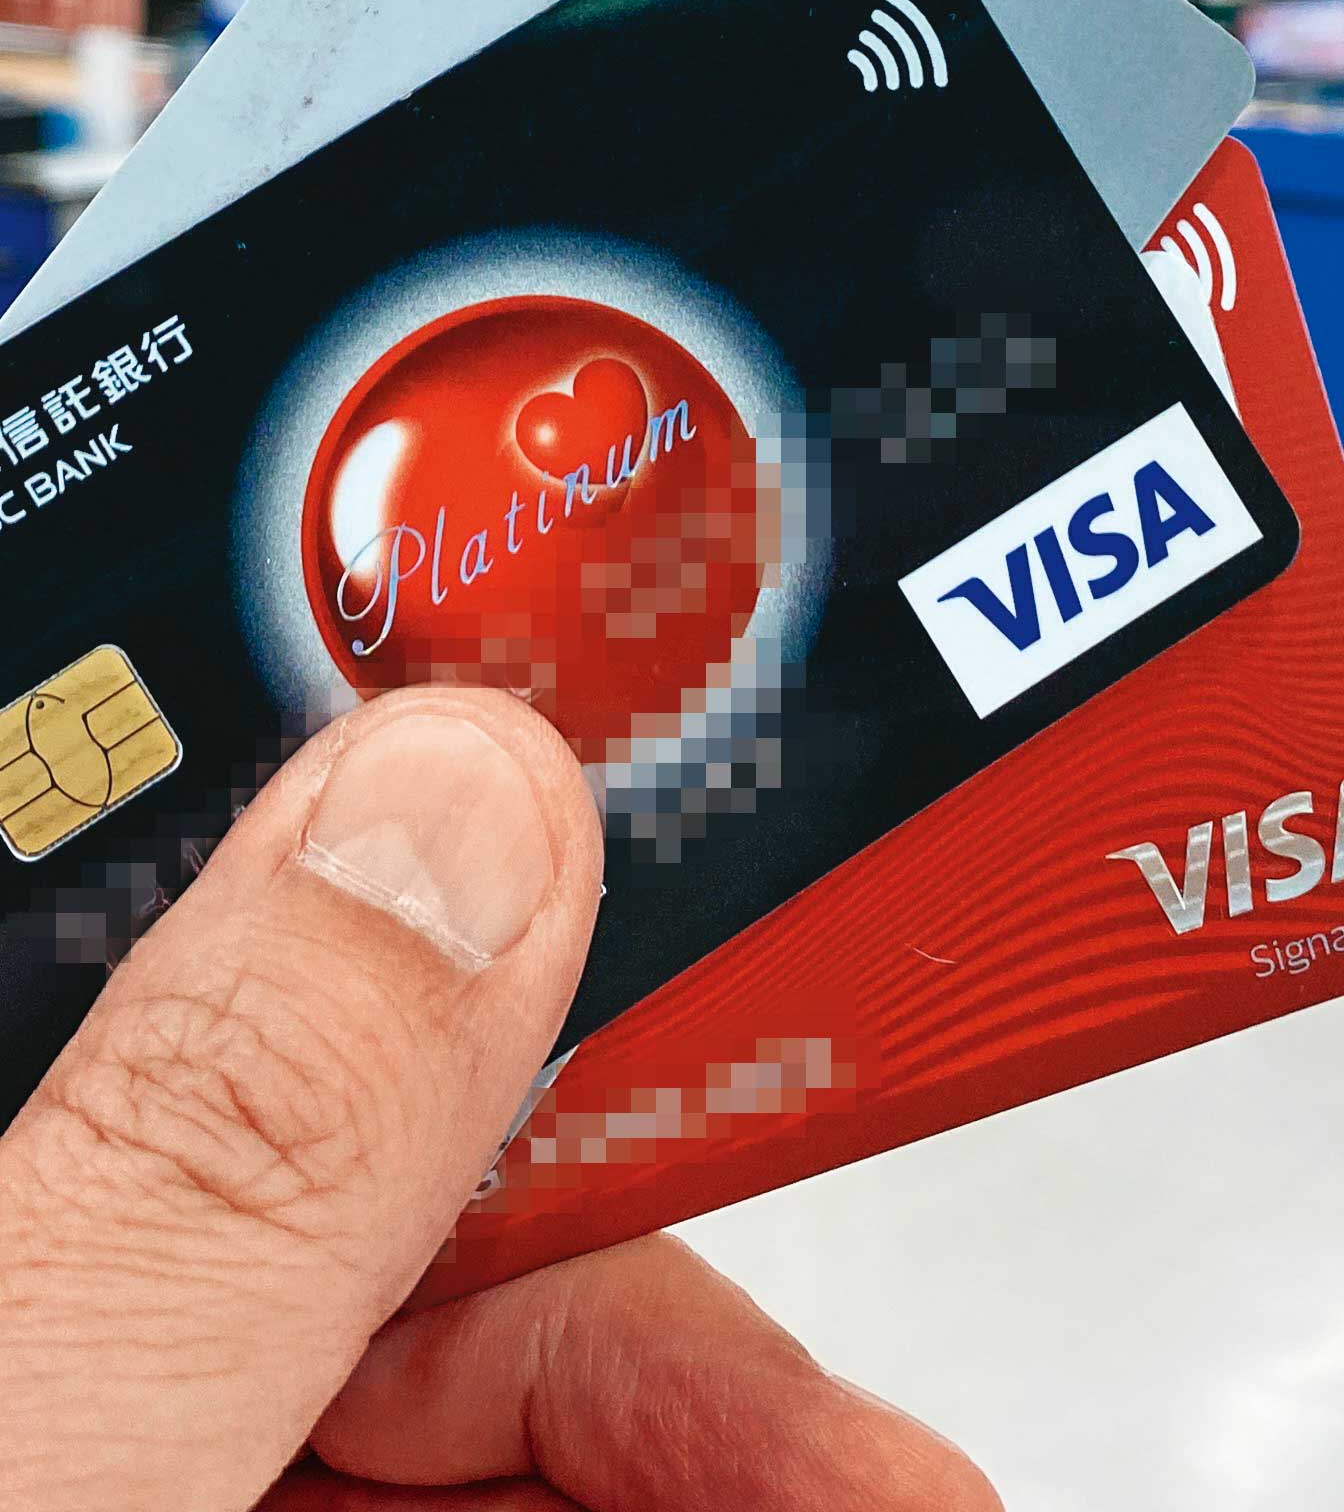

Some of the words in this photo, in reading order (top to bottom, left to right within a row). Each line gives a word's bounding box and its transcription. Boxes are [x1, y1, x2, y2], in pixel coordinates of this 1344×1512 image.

[24, 423, 133, 508] BANK
[336, 398, 698, 657] Platinum
[937, 460, 1216, 652] VISA
